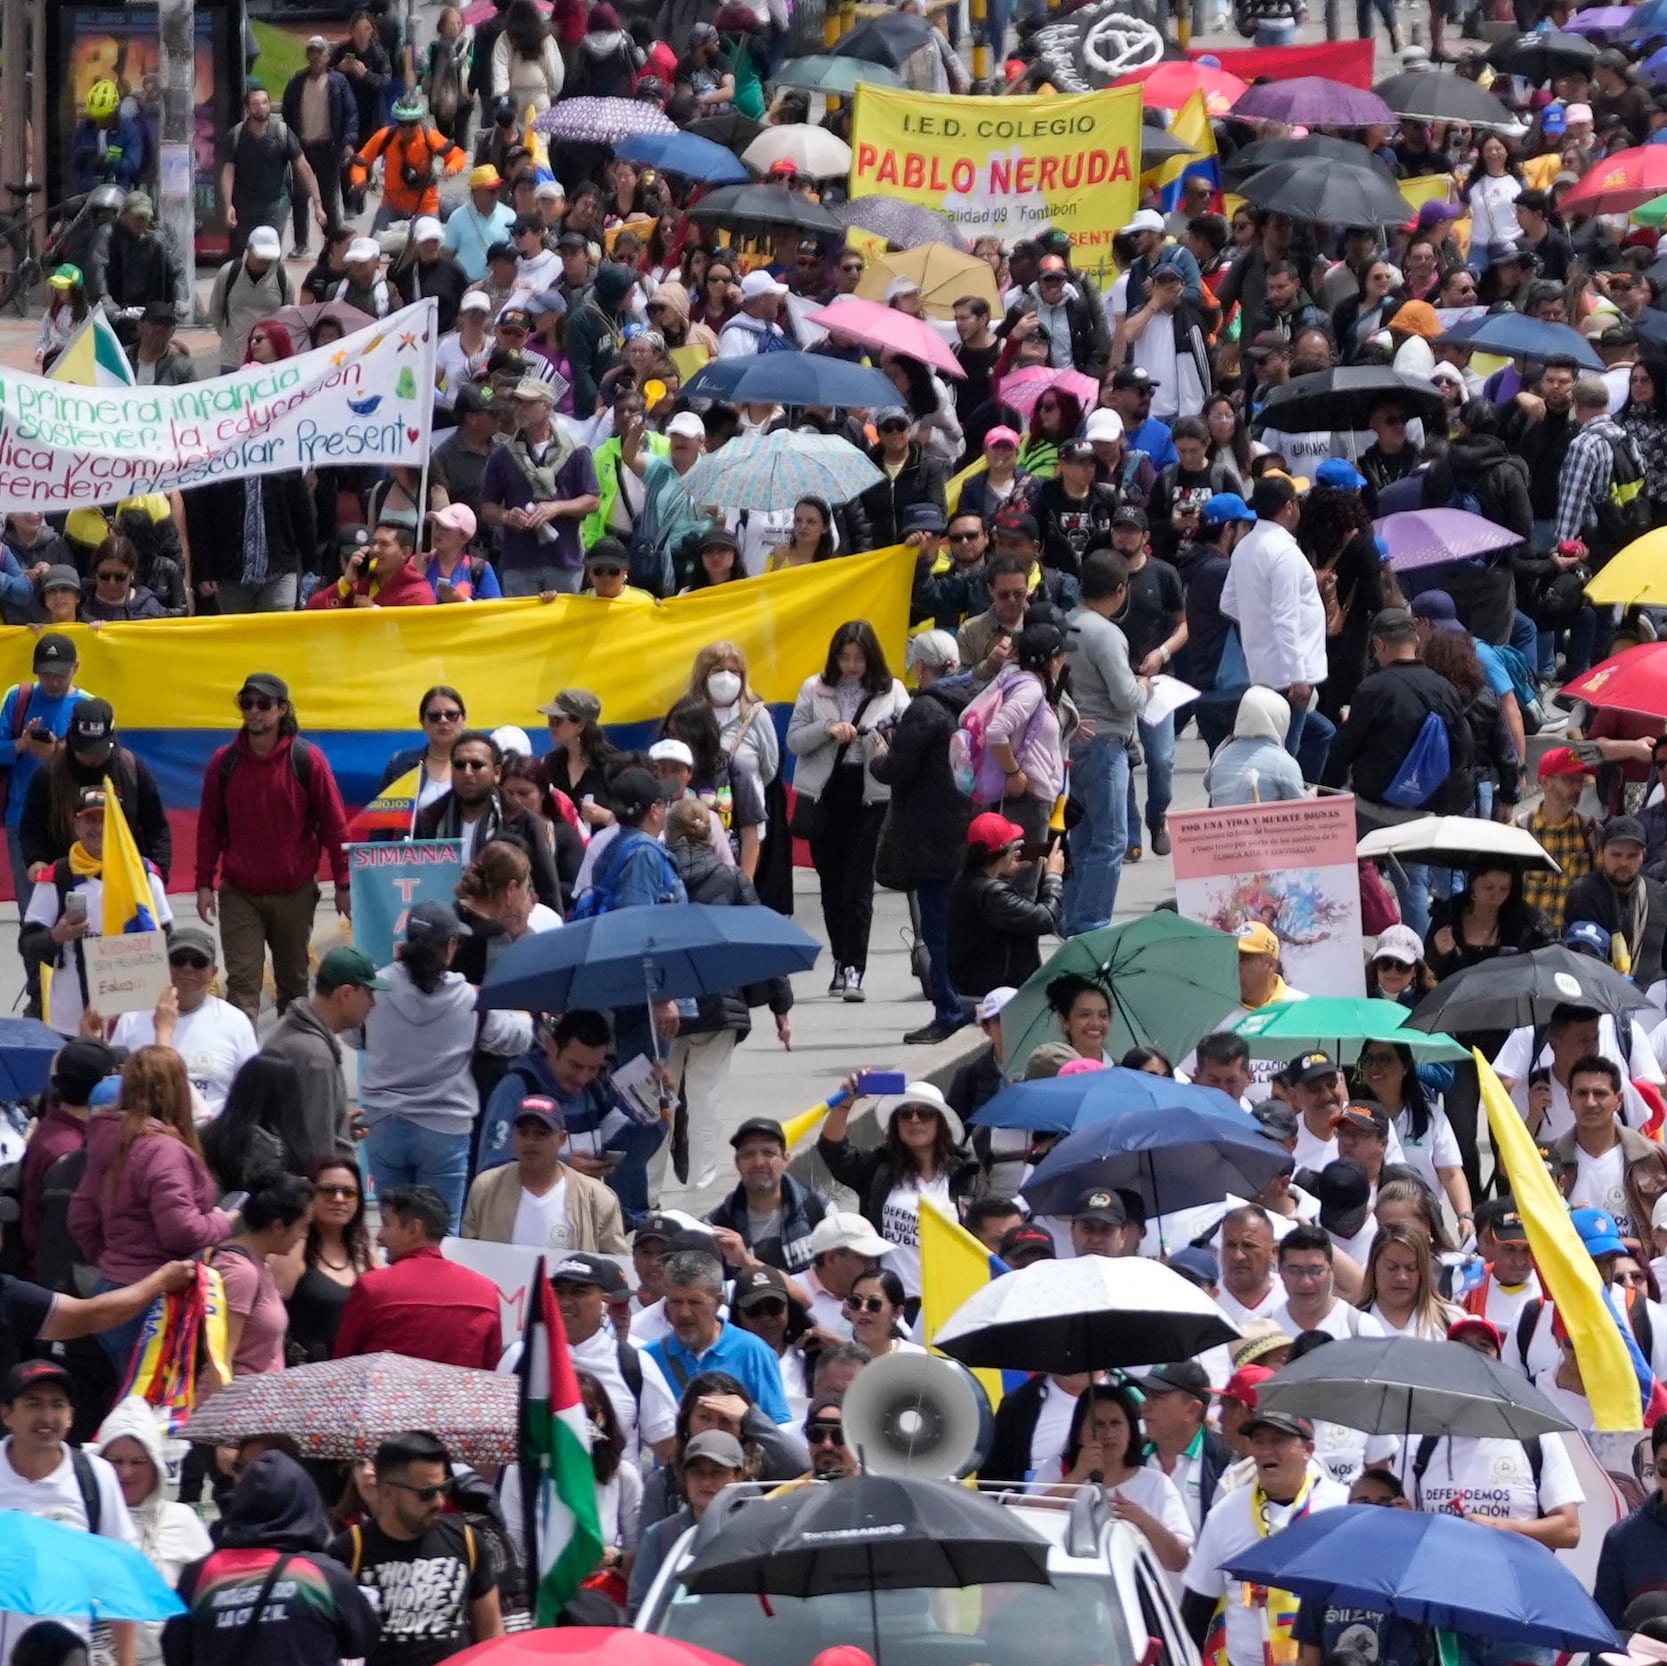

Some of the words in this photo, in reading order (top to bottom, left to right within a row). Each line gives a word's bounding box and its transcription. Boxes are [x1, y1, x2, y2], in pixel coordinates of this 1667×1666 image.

[904, 113, 968, 143] I.E.D.
[977, 115, 1097, 145] COLEGIO
[857, 143, 978, 196] PABLO
[989, 146, 1134, 196] NERUDA
[16, 383, 162, 429] primera
[171, 365, 300, 422] infancia
[355, 845, 459, 869] SIMANA
